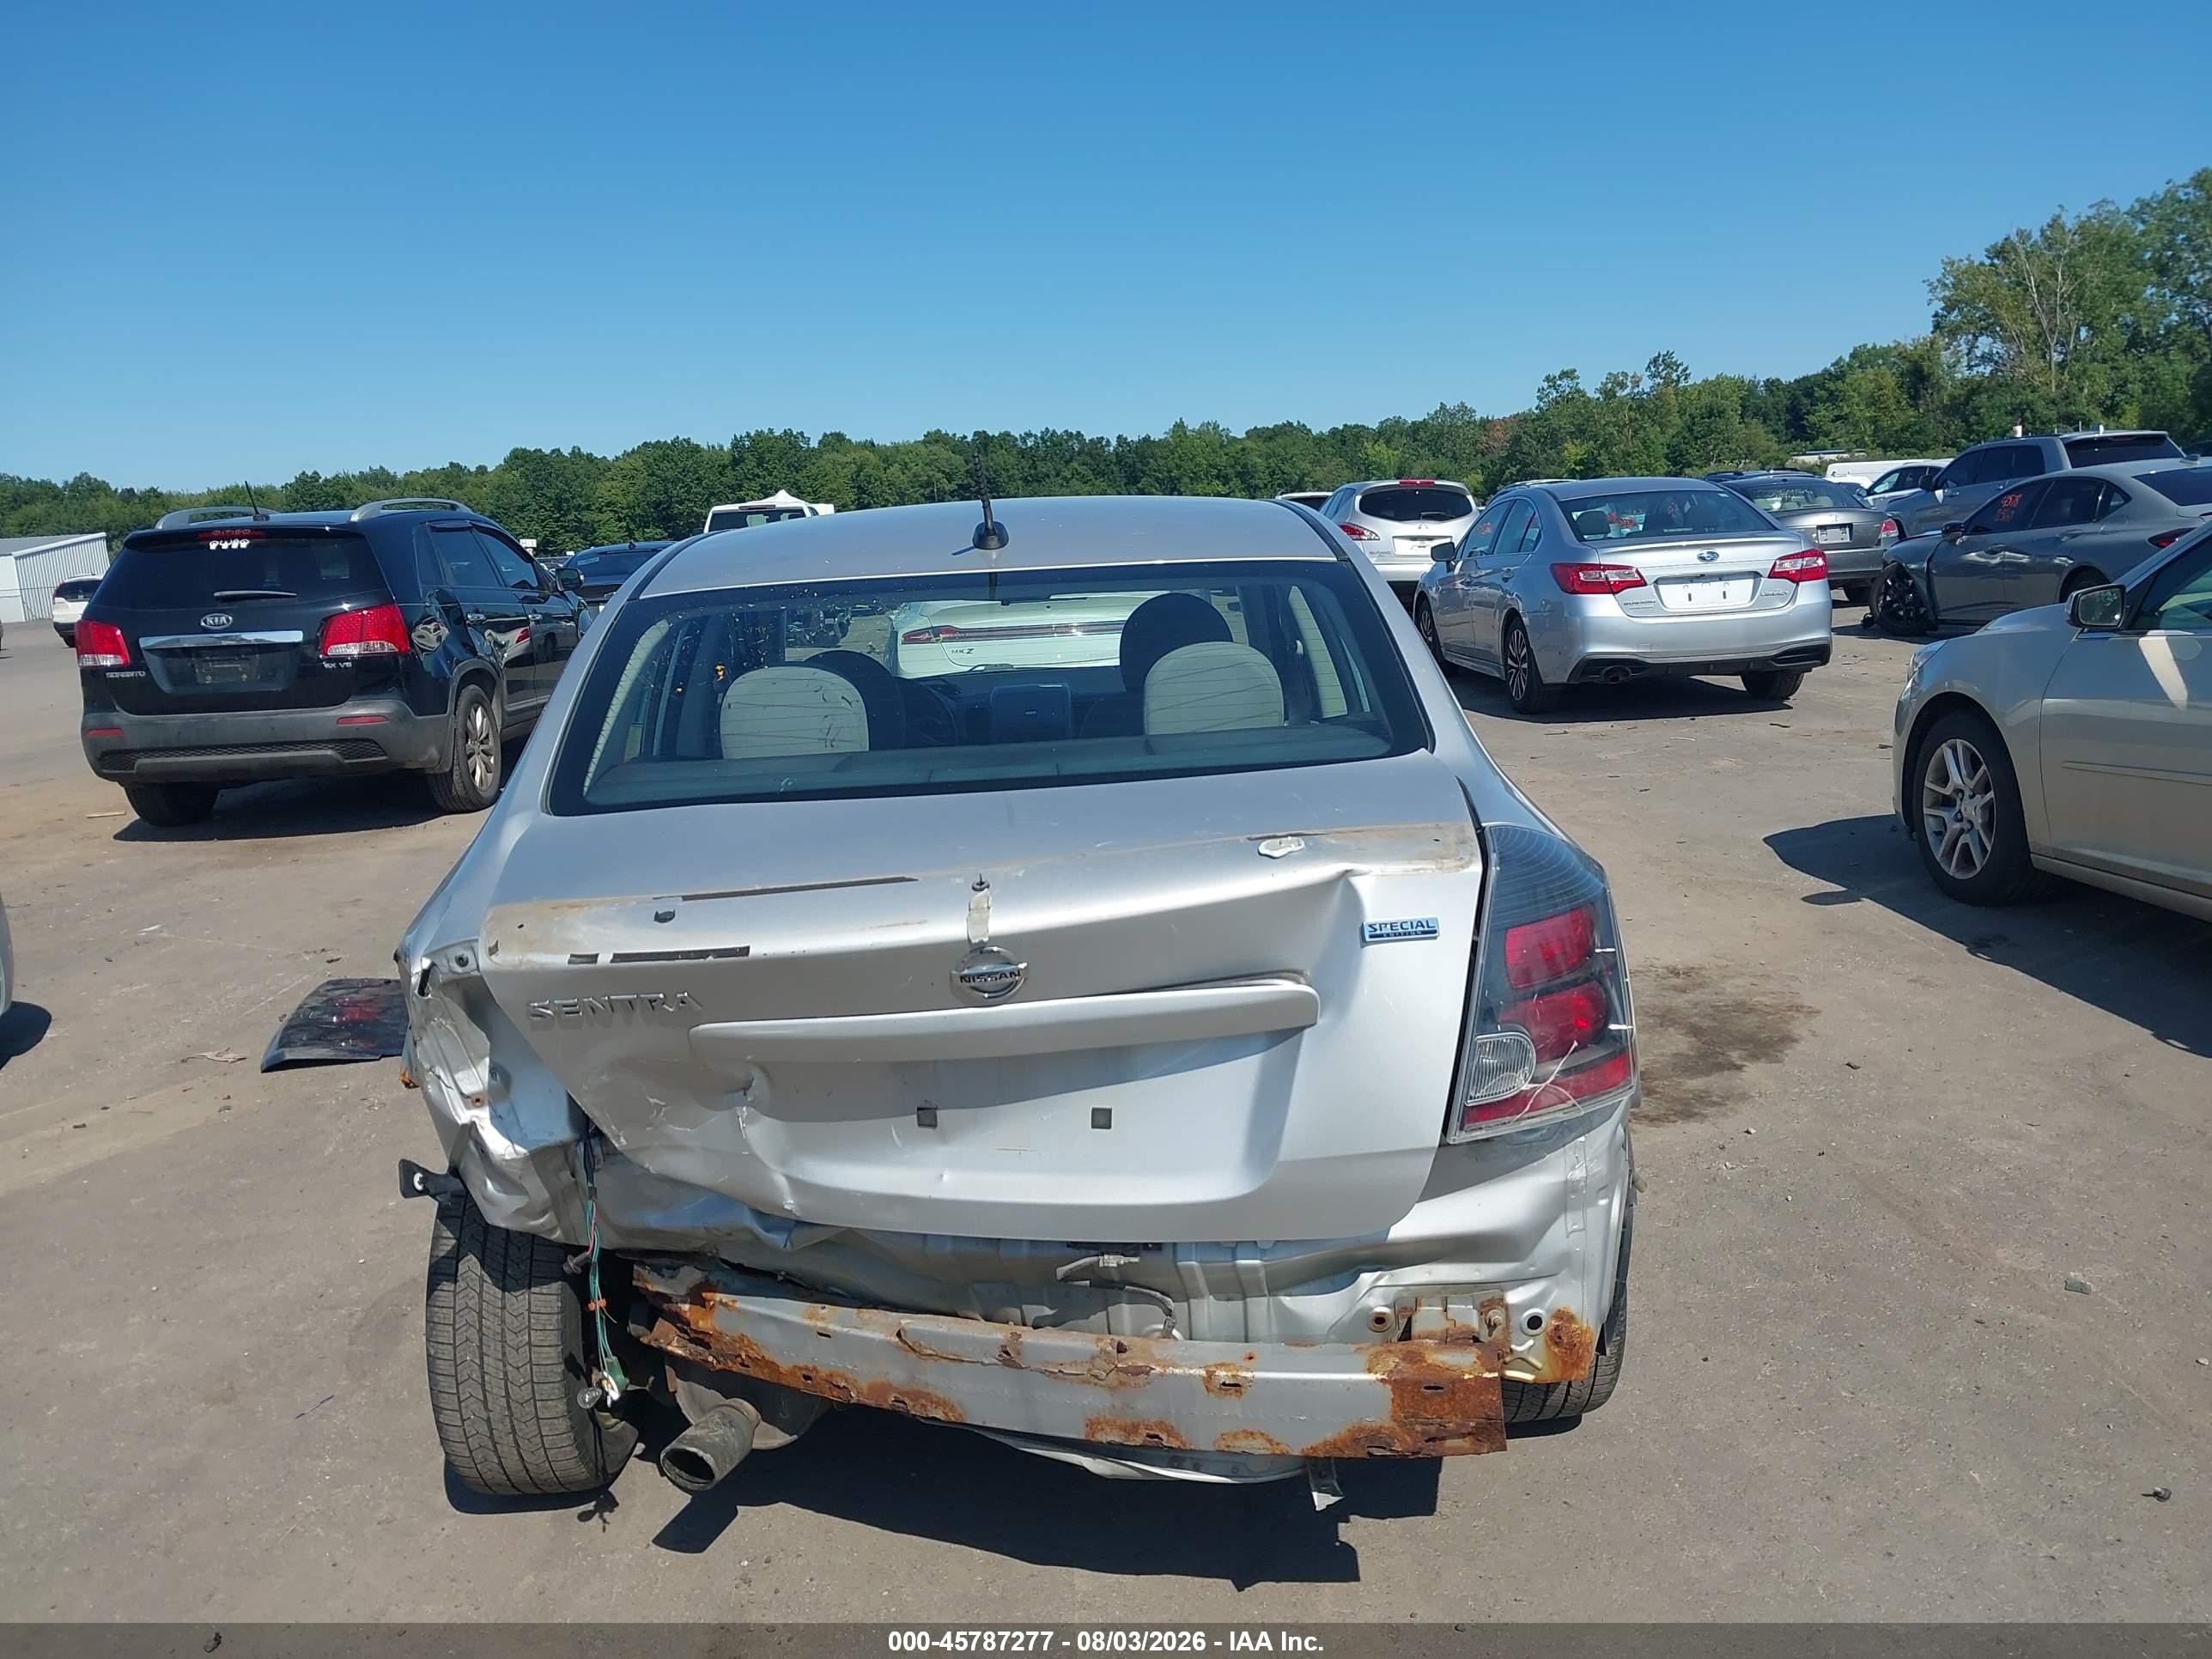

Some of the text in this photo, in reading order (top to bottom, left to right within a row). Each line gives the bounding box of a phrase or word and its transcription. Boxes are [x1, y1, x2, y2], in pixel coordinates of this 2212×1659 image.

[205, 616, 228, 626] KIA
[1367, 920, 1437, 933] SPECIAL
[959, 969, 1022, 983] NISSAN
[527, 991, 704, 1022] SENTRA
